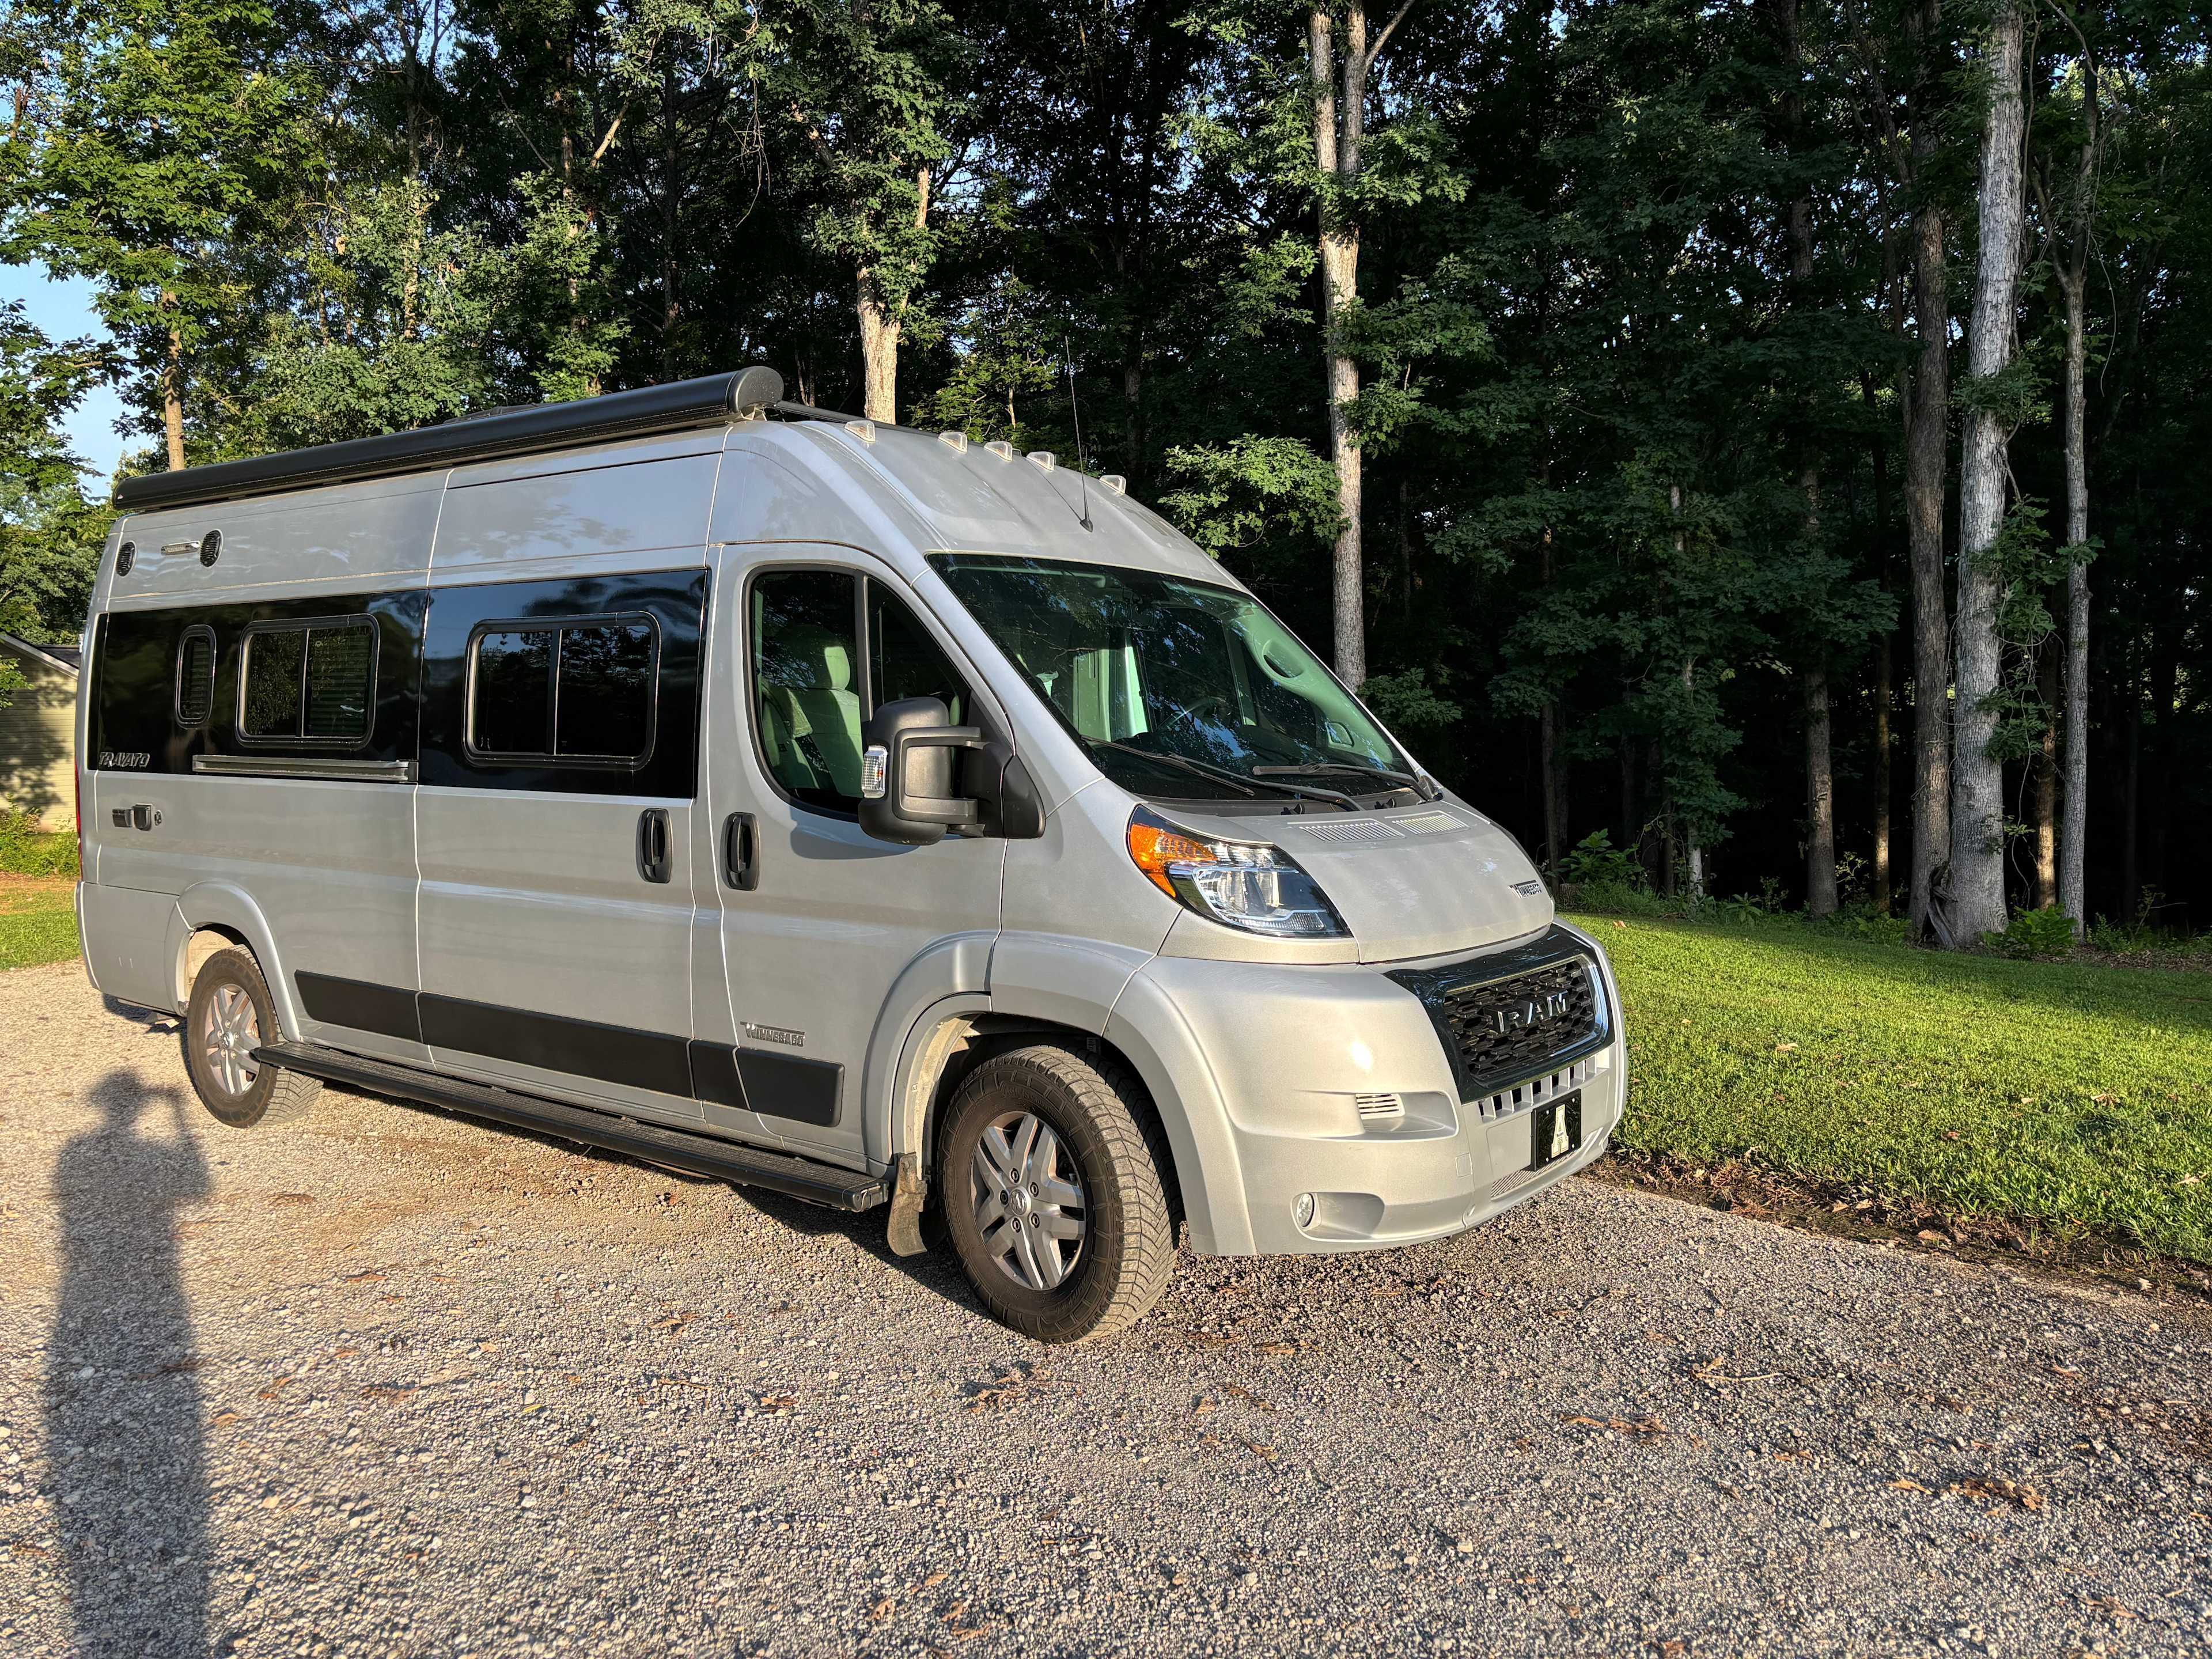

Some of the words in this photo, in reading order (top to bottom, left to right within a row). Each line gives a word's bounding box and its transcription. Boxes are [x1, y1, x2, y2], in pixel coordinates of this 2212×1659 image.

[99, 752, 150, 768] TRAVATO
[1484, 989, 1570, 1034] RAM
[740, 1021, 805, 1047] WINNEBAGO
